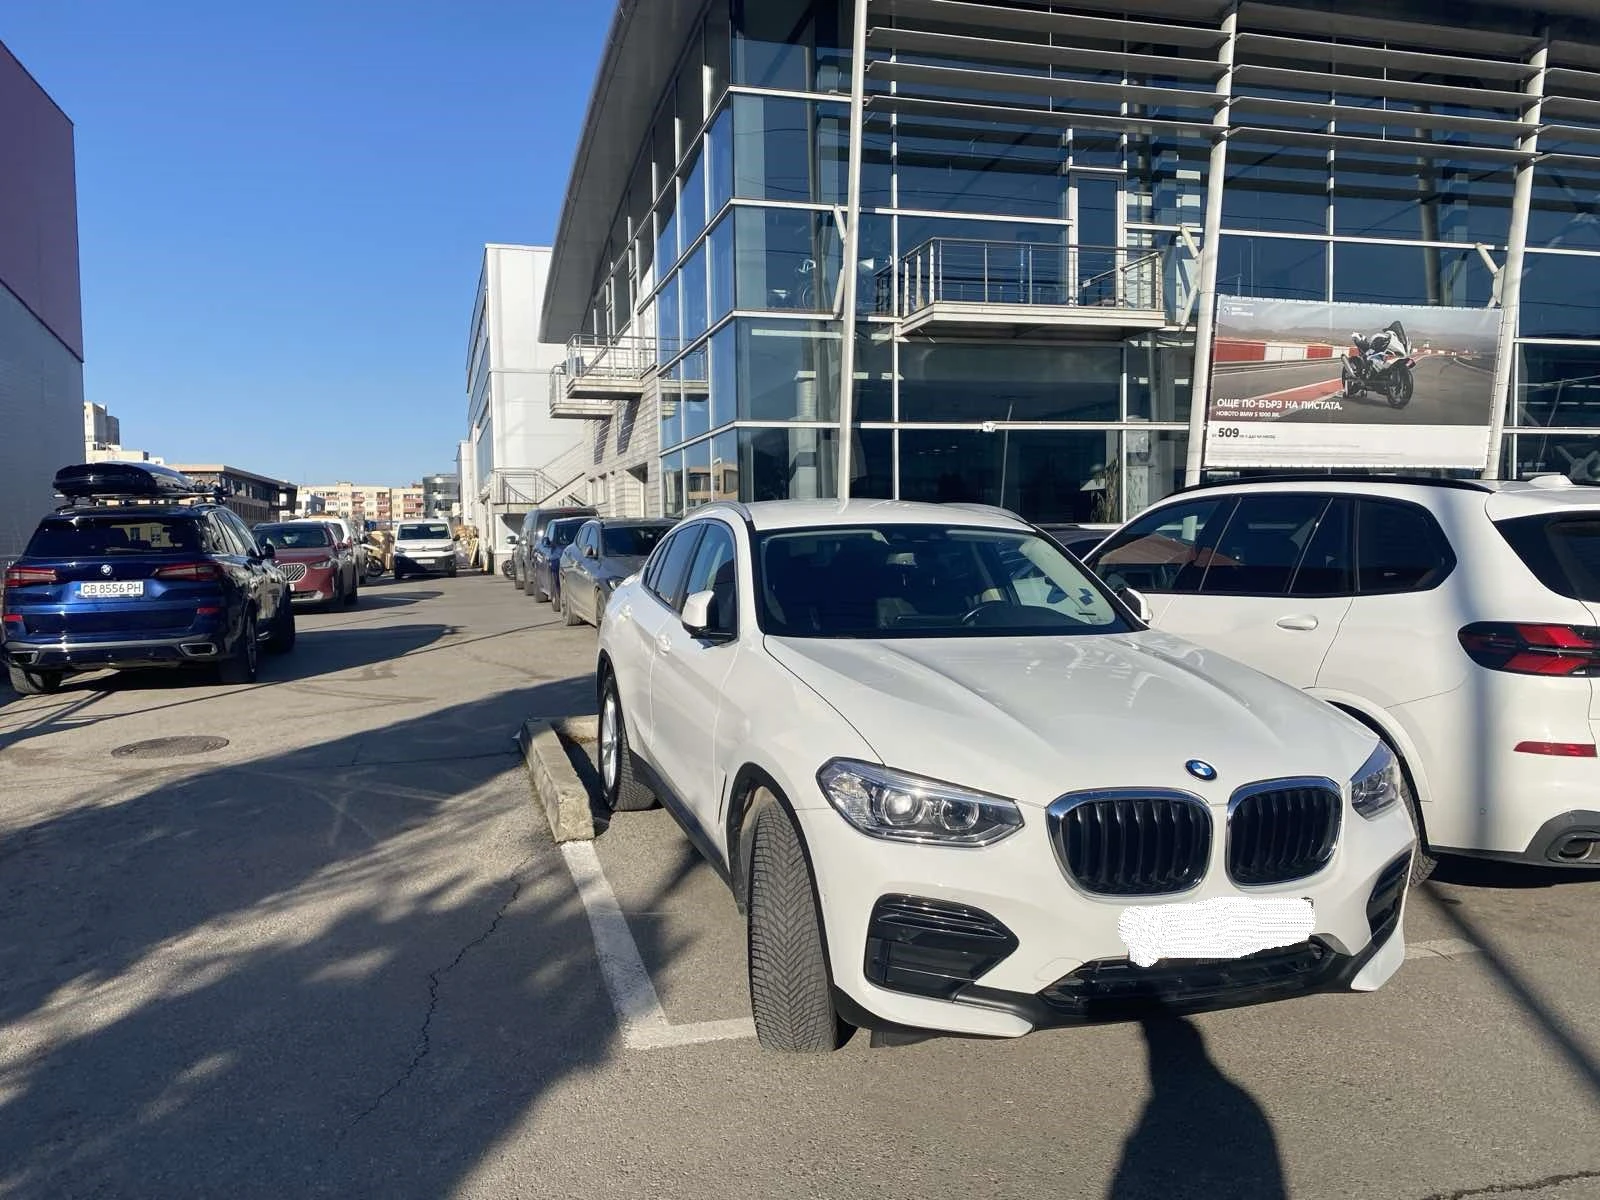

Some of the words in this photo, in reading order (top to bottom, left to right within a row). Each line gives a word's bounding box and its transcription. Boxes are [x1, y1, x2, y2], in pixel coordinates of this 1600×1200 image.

[1217, 398, 1240, 409] ОЩЕ
[1242, 399, 1282, 409] ПО-БЪРЗ
[1285, 400, 1298, 409] НА
[1301, 400, 1344, 411] ПИСТАТА.
[1218, 427, 1239, 438] 509
[83, 584, 97, 595] CB
[99, 583, 125, 594] 8556
[127, 583, 141, 593] PH
